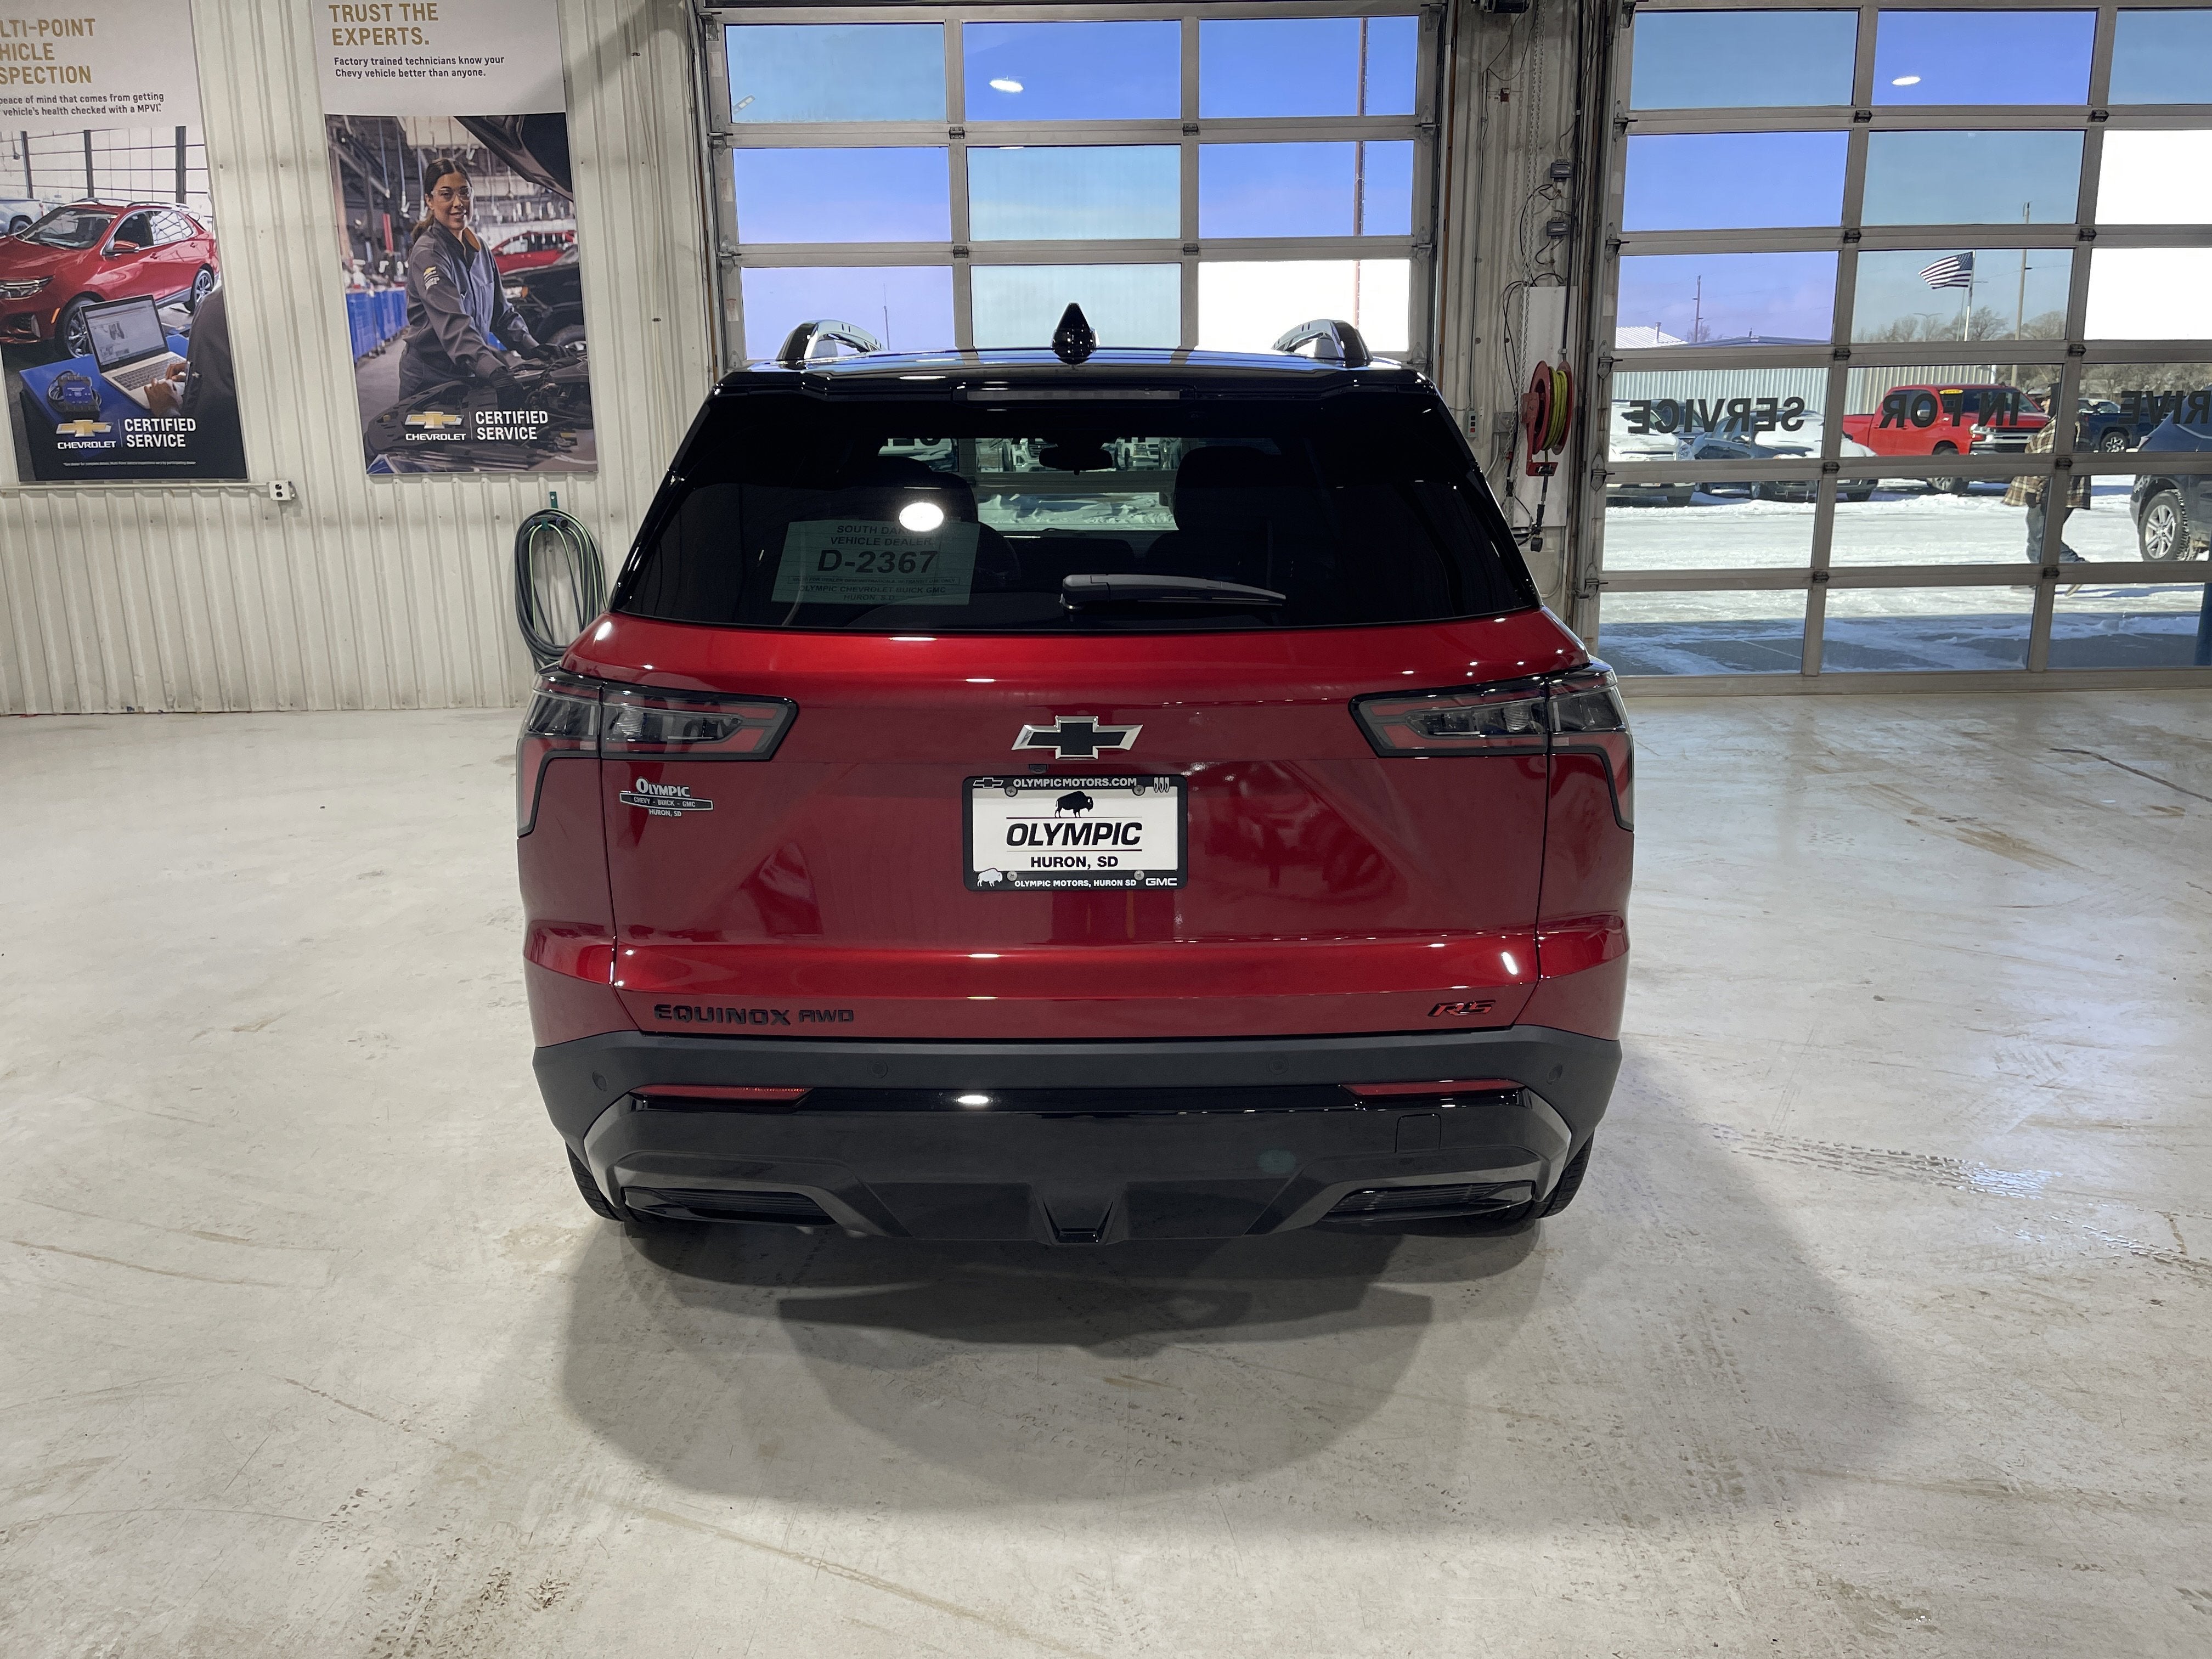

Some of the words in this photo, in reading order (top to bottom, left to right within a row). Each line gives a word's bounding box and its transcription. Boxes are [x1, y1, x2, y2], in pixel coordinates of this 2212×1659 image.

[329, 4, 393, 22] TRUST
[398, 3, 439, 21] THE
[332, 27, 430, 46] EXPERTS.
[334, 57, 368, 67] Factory
[370, 57, 403, 65] trained
[405, 56, 456, 65] technicians
[459, 56, 482, 64] know
[484, 55, 505, 66] your
[336, 69, 362, 79] Chevy
[365, 68, 396, 77] vehicle
[399, 68, 426, 77] better
[428, 68, 449, 77] than
[452, 70, 486, 79] anyone.
[25, 95, 33, 104] of
[36, 95, 57, 104] mind
[110, 94, 131, 102] from
[133, 92, 164, 103] getting
[3, 107, 40, 116] vehicle's
[41, 106, 69, 115] health
[71, 105, 106, 114] checked
[108, 105, 128, 114] with
[476, 410, 549, 425] CERTIFIED
[124, 418, 196, 432] CERTIFIED
[405, 433, 466, 441] CHEVROLET
[477, 427, 537, 441] SERVICE
[57, 441, 116, 450] CHEVROLET
[126, 435, 186, 448] SERVICE
[837, 525, 878, 534] SOUTH
[830, 537, 881, 546] VEHICLE
[817, 550, 938, 574] D-2367
[636, 778, 690, 797] OLYMPIC
[1013, 778, 1137, 787] OLYMPICMOTORS.COM
[649, 809, 673, 817] HURON,
[1006, 822, 1142, 846] OLYMPIC
[1030, 856, 1091, 870] HURON,
[1097, 856, 1118, 867] SD
[1053, 880, 1091, 888] MOTORS,
[1146, 878, 1177, 886] GMC
[1428, 1000, 1496, 1017] RS
[654, 1004, 791, 1026] EQUINOX
[799, 1009, 854, 1023] AWD
